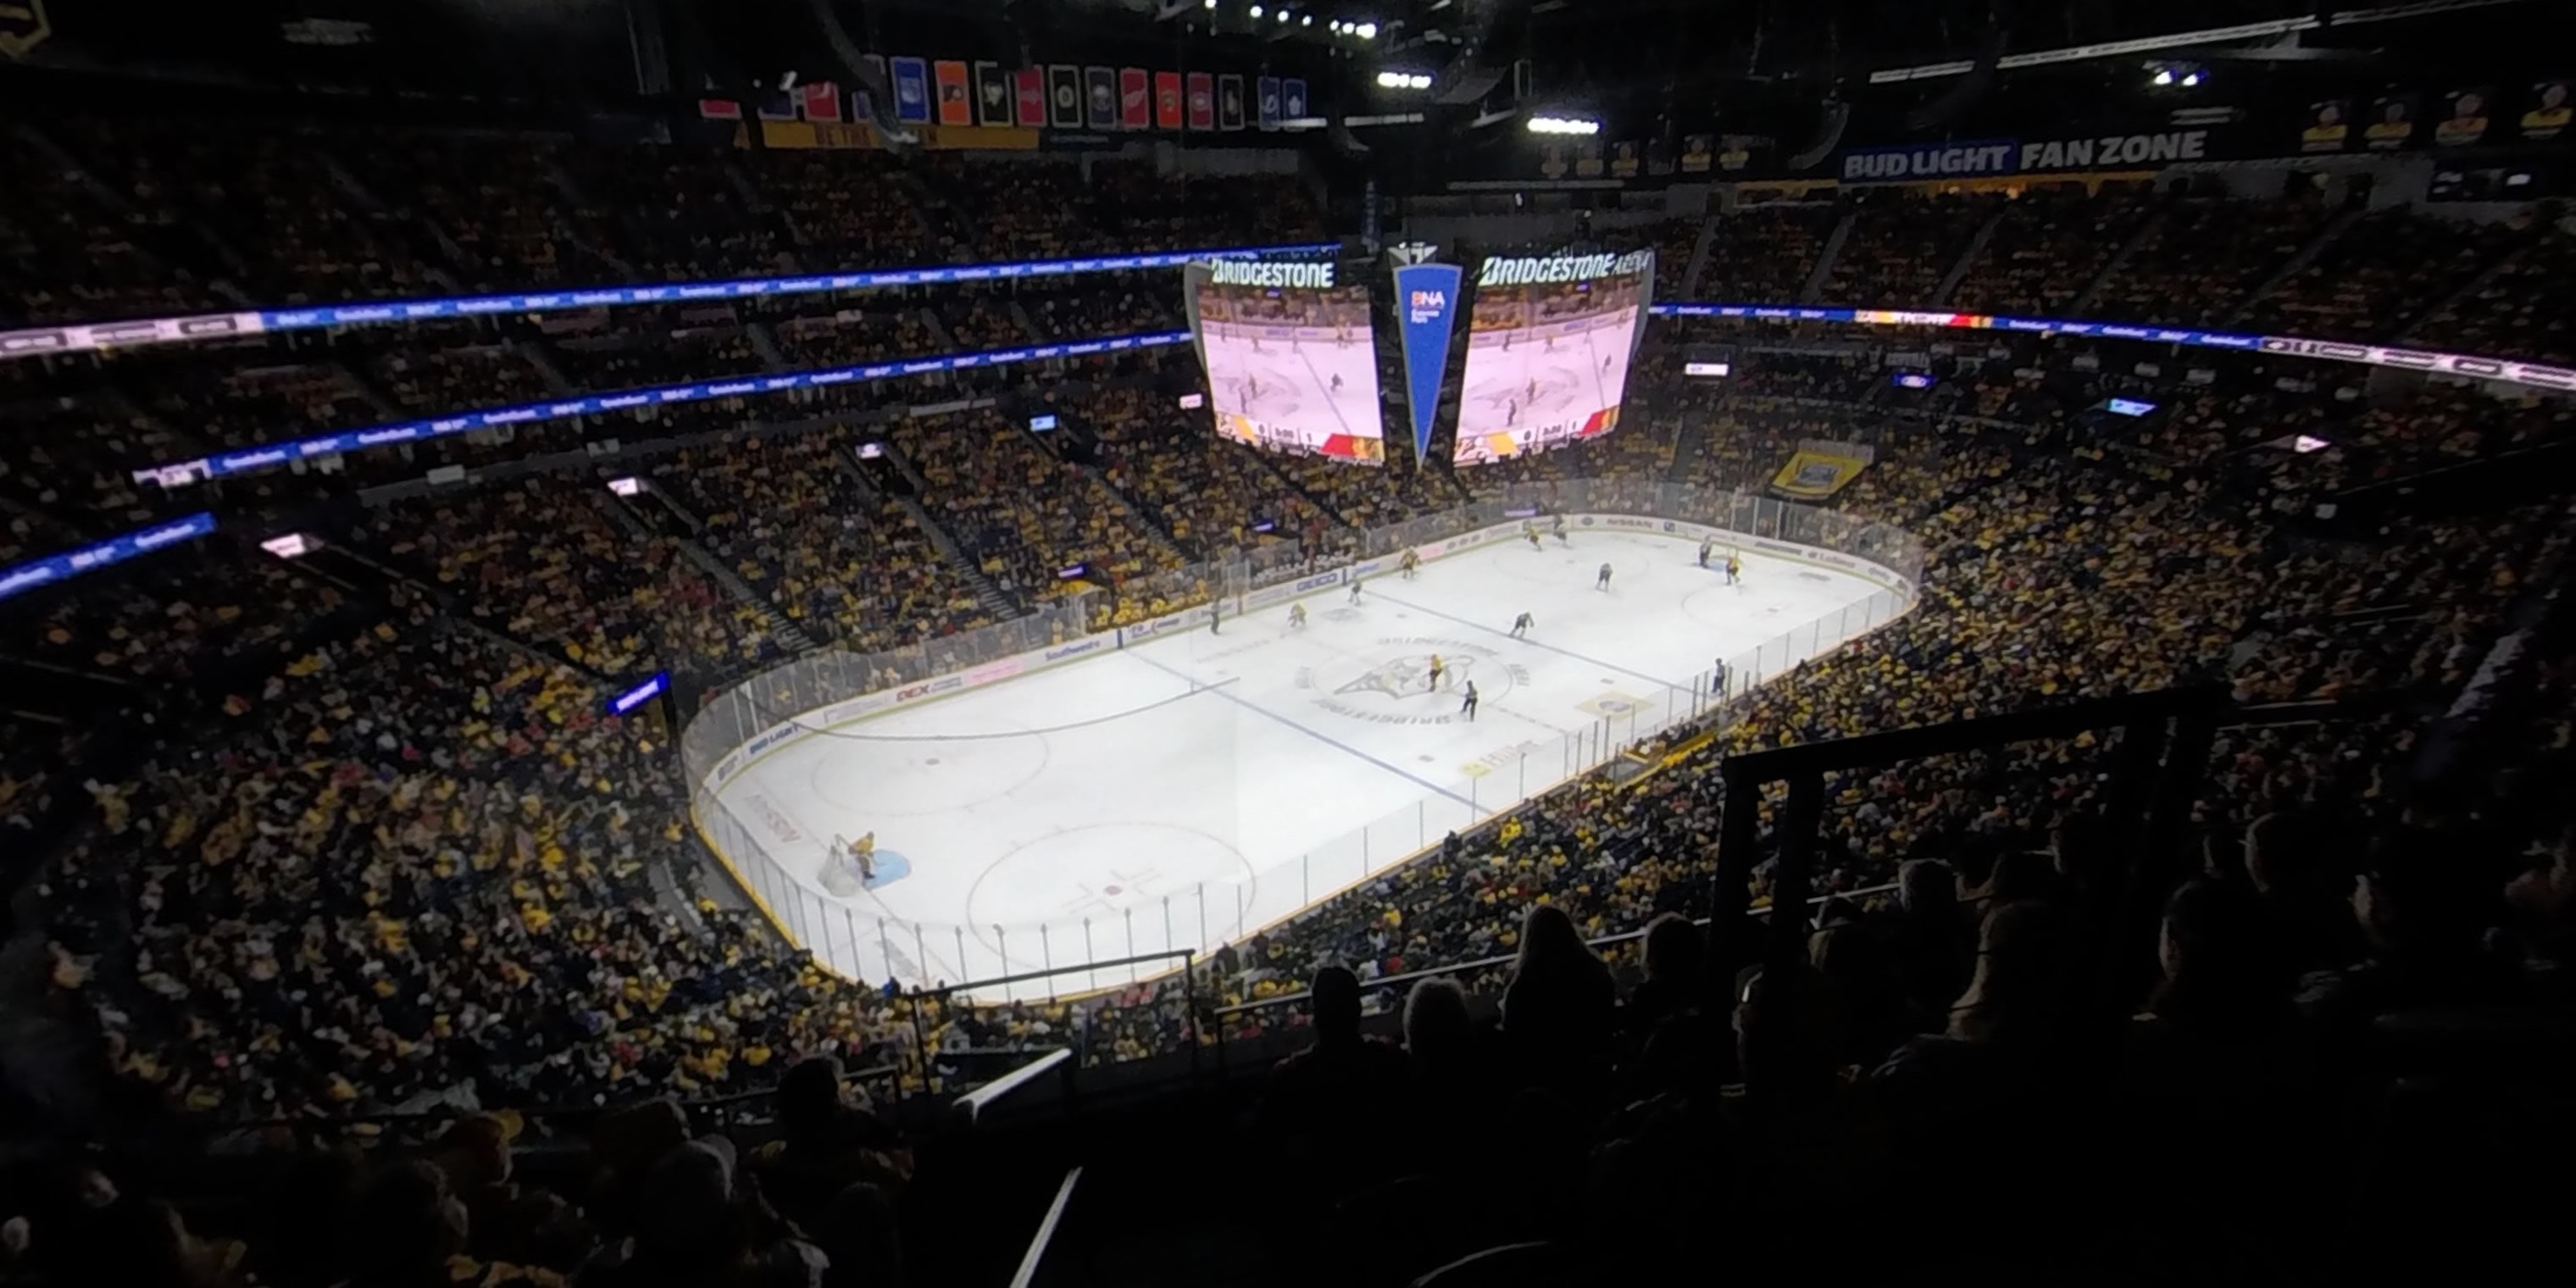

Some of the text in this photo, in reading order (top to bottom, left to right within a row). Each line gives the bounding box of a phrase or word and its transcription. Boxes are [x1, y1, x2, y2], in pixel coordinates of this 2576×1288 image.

[1843, 129, 2209, 178] BUD LIGHT FAN ZONE
[1211, 258, 1335, 288] BRIDGESTONE
[1478, 253, 1615, 286] BRIDGESTONE
[1411, 291, 1446, 308] BNA
[1296, 571, 1338, 591] GEICO
[1045, 641, 1094, 662] Southwest
[896, 683, 930, 702] DEX
